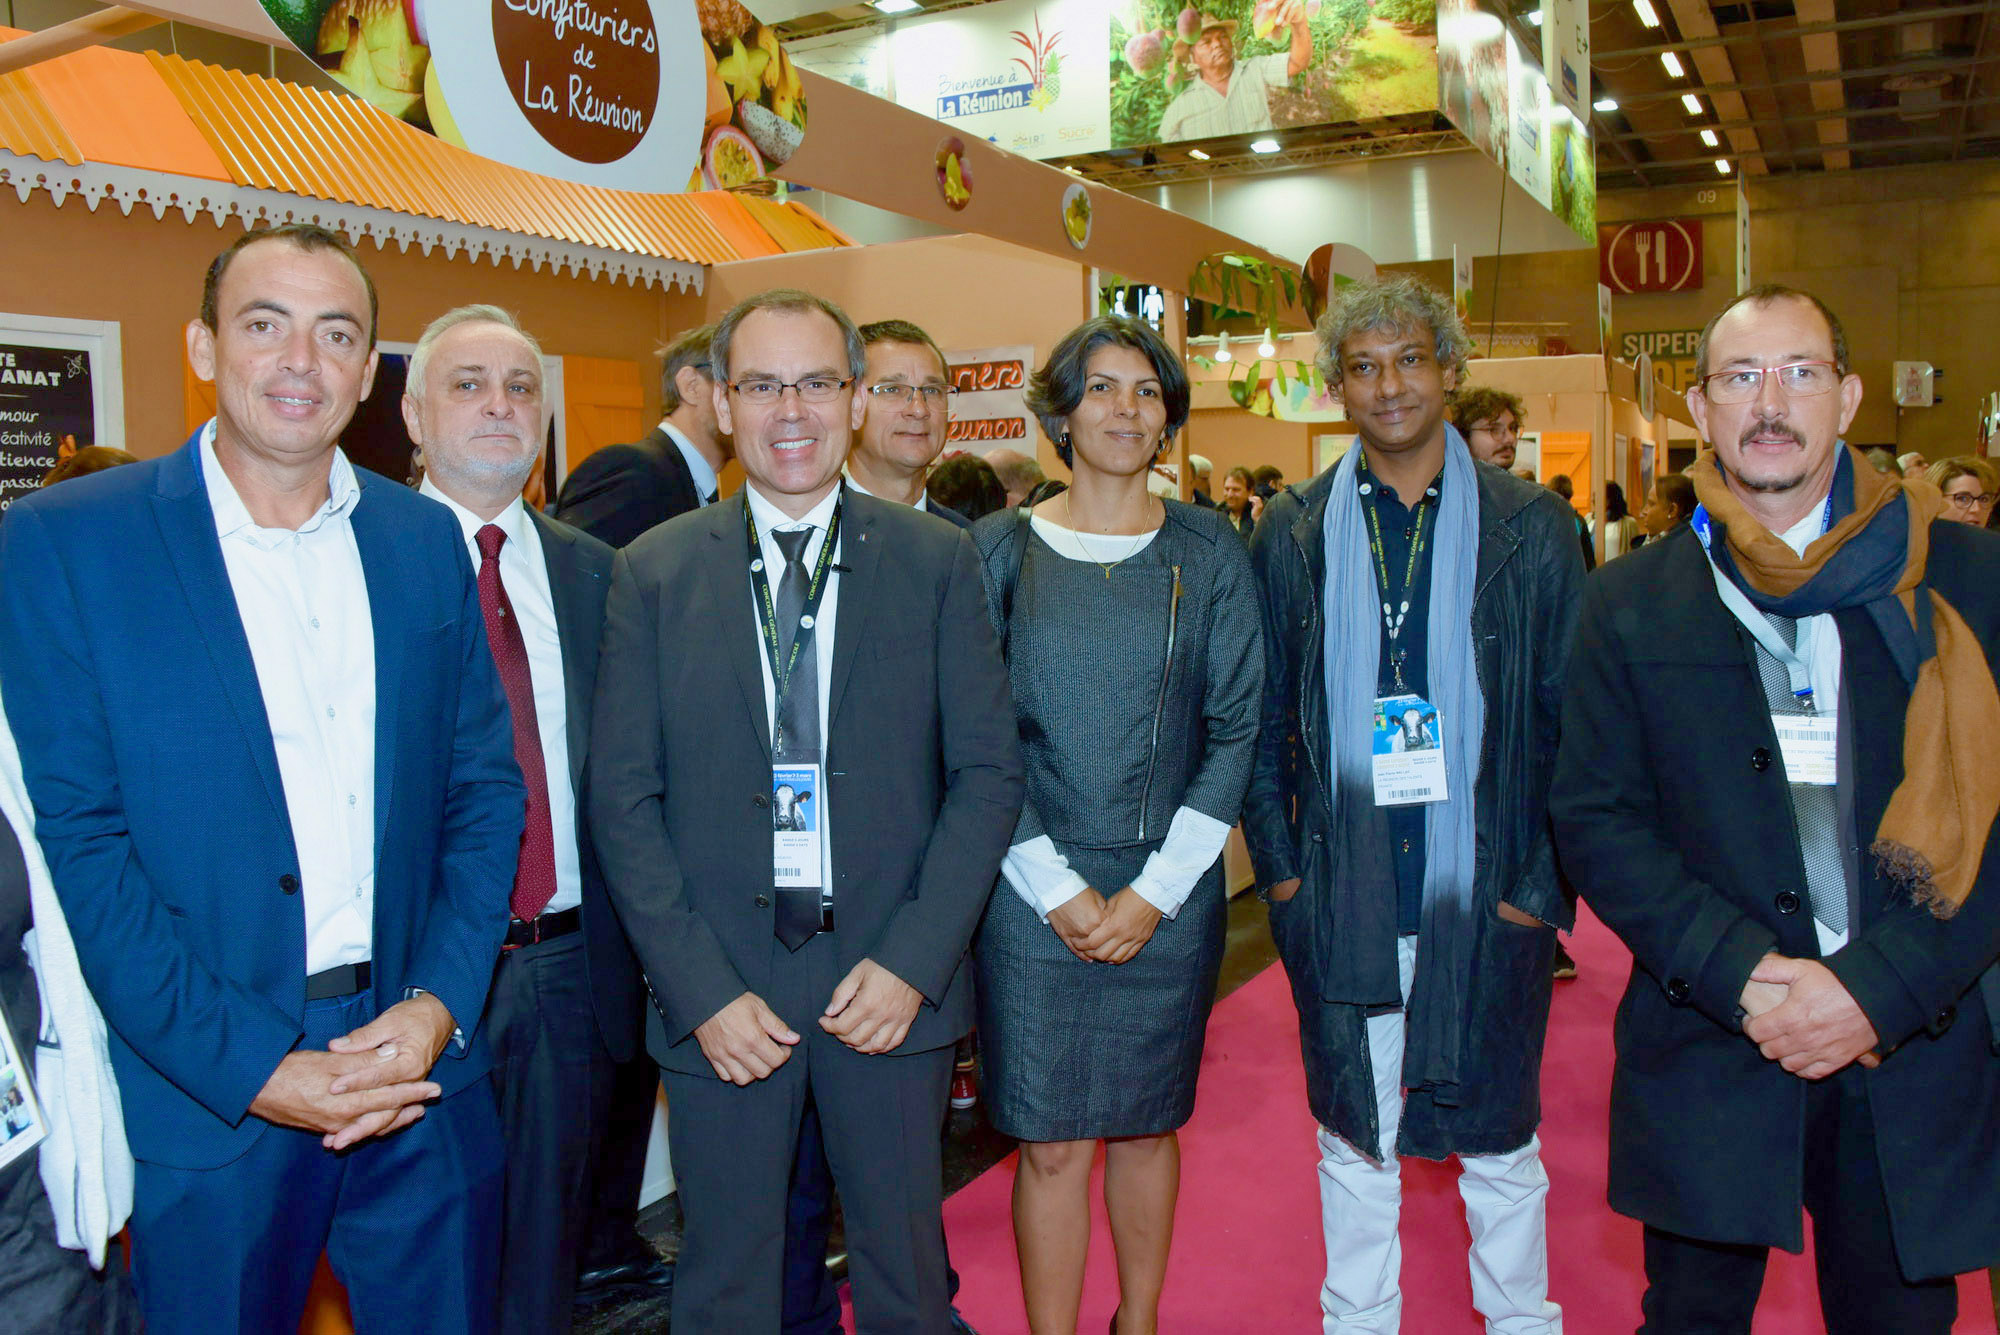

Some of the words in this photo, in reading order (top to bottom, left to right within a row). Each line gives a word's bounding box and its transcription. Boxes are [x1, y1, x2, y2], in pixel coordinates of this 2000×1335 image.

[574, 43, 596, 69] de
[938, 74, 1005, 95] Bienvenue
[1008, 67, 1019, 83] à
[524, 60, 558, 113] La
[568, 74, 643, 134] Réunion
[938, 98, 956, 118] La
[959, 90, 1023, 115] Réunion
[1697, 190, 1716, 204] 09
[1624, 333, 1698, 356] SUPER
[1, 369, 61, 387] ANAT
[946, 413, 1025, 441] éunion
[808, 568, 822, 600] CONCOURS
[762, 584, 773, 618] CONCOURS
